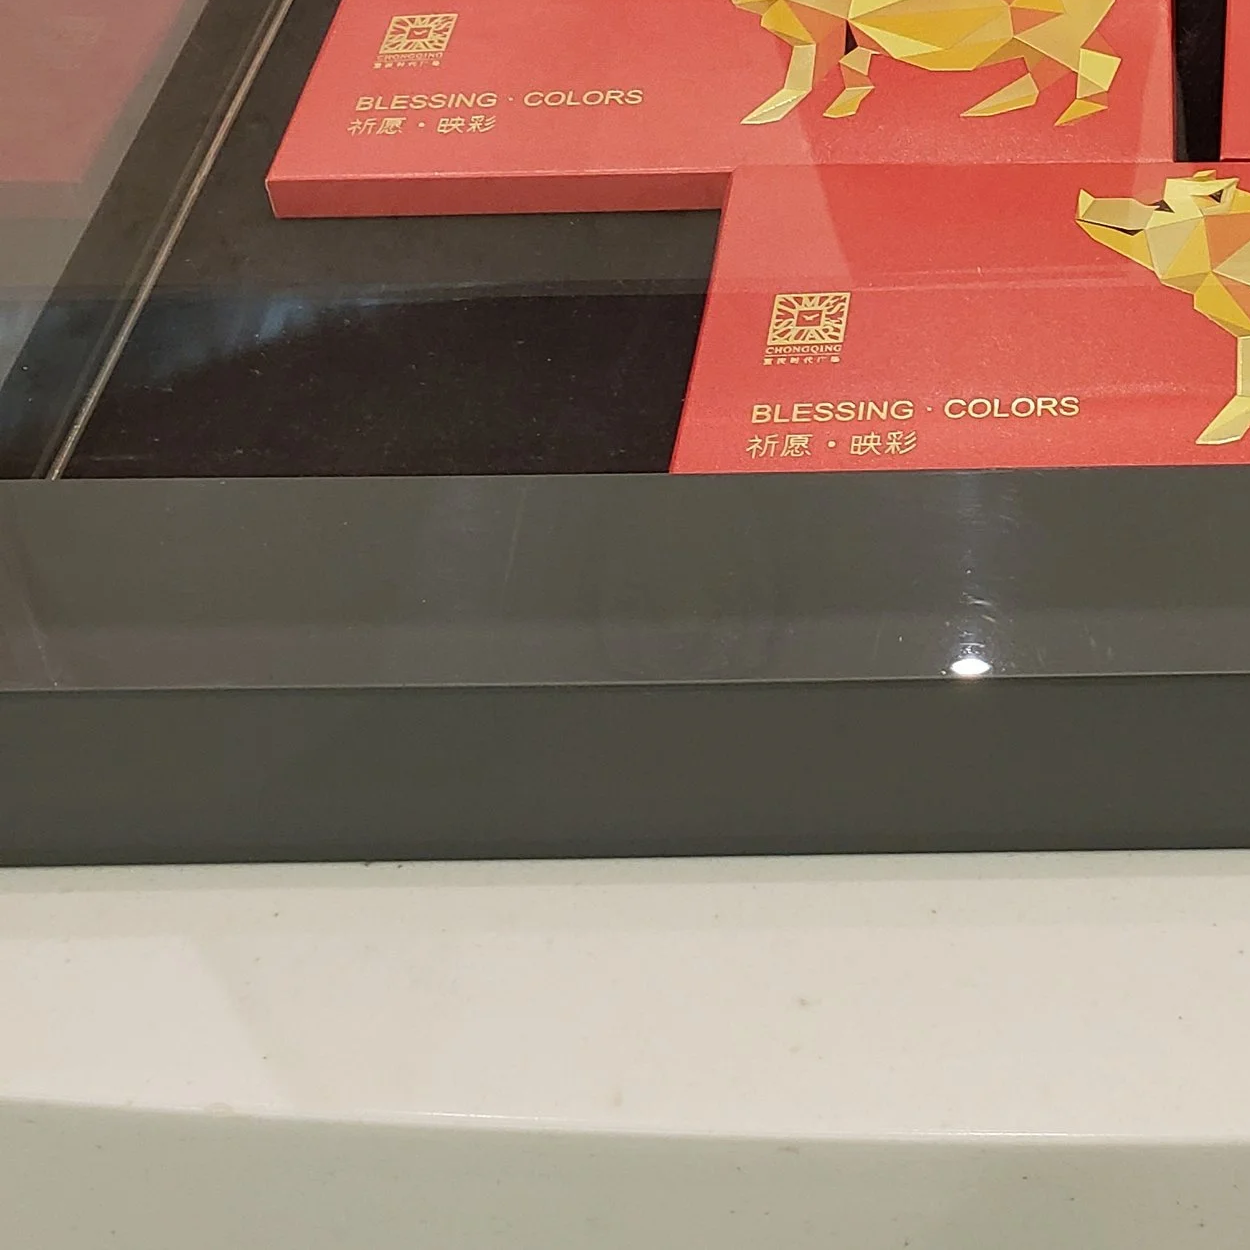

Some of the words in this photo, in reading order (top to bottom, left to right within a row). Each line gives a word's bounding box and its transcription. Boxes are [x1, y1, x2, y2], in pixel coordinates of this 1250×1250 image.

[355, 92, 498, 112] BLESSING
[523, 90, 644, 107] COLORS
[765, 344, 842, 354] CHONGQING
[751, 400, 914, 424] BLESSING
[944, 396, 1080, 419] COLORS
